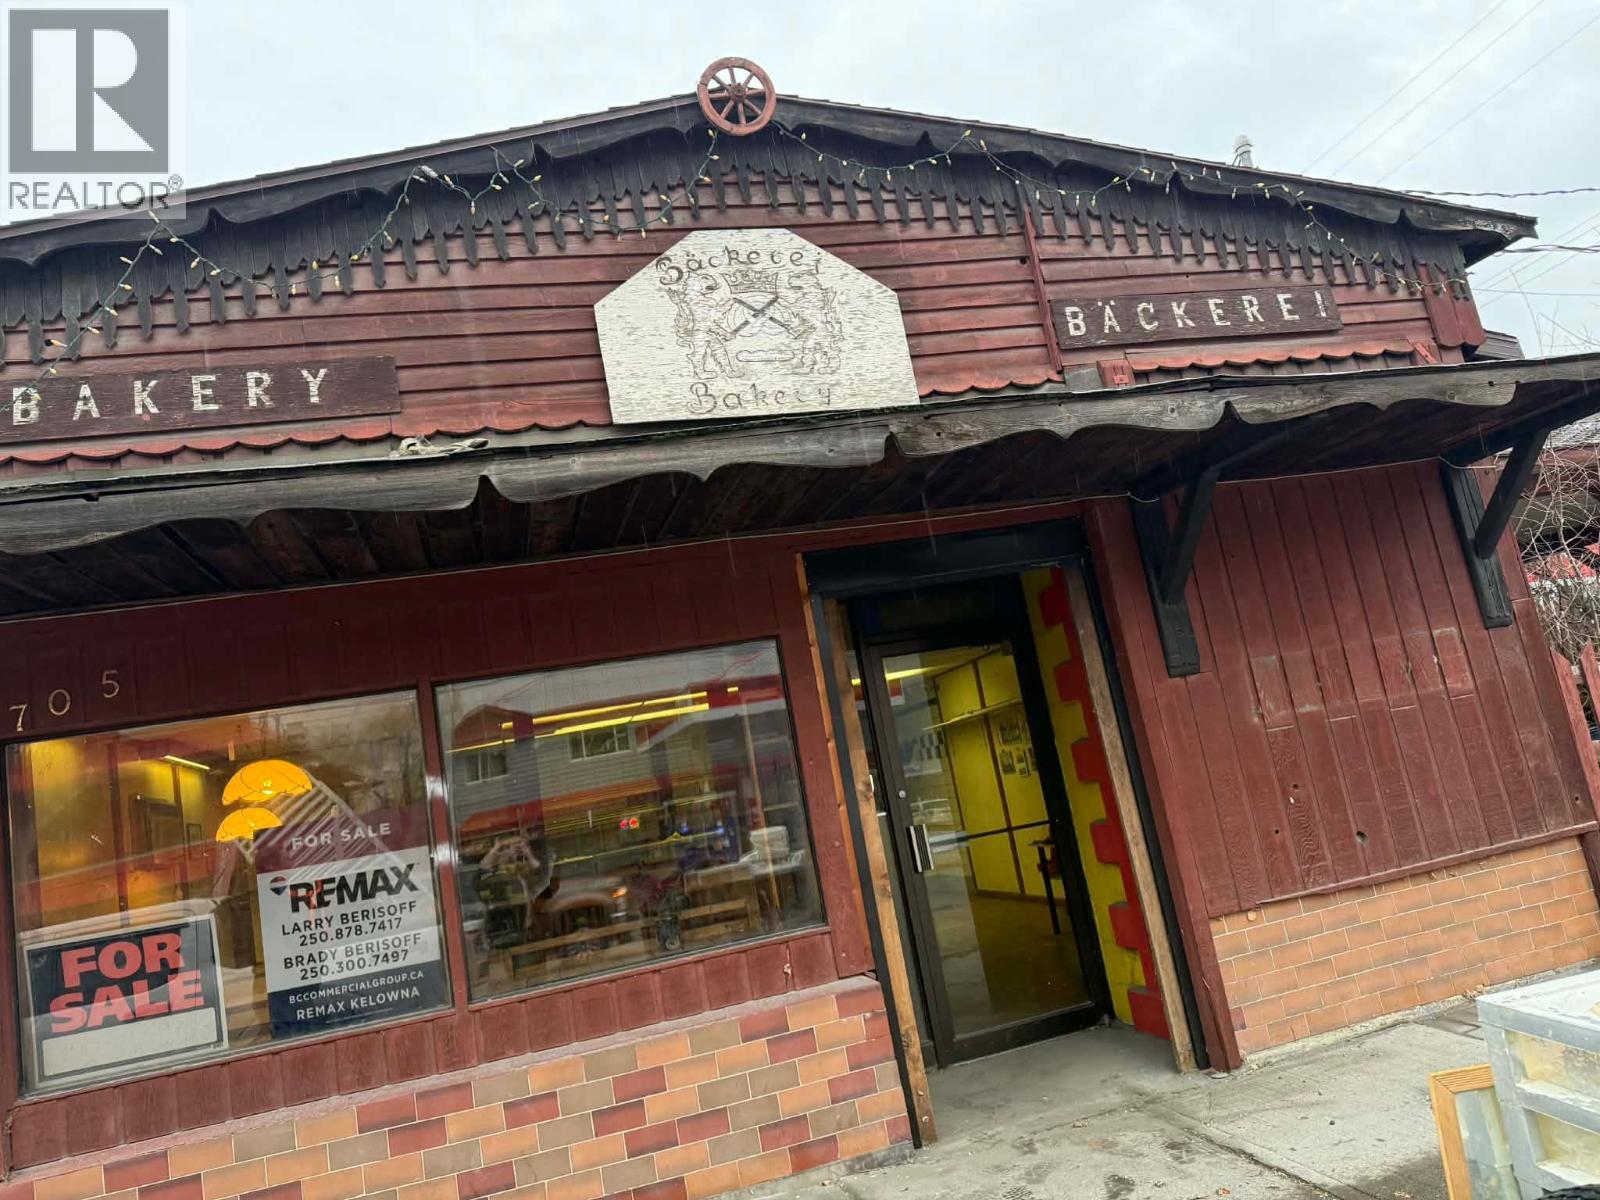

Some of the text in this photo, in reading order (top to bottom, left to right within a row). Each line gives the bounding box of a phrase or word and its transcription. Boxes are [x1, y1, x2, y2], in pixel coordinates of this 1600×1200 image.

[1064, 290, 1328, 337] BÄCKEREI
[12, 368, 328, 426] BAKERY
[688, 382, 831, 415] Bakery
[291, 822, 392, 851] FOR SALE
[289, 863, 419, 913] REMAX
[281, 900, 417, 936] LARRY BERISOFF
[299, 917, 403, 947] 250.878.7417
[60, 932, 185, 989] FOR
[283, 932, 422, 970] BRADY BERISOFF
[300, 949, 409, 981] 250.300.7497
[50, 969, 205, 1034] SALE
[289, 970, 424, 1004] BCCOMMERCIALGROUP.CA
[296, 986, 421, 1021] REMAX KELOWNA
